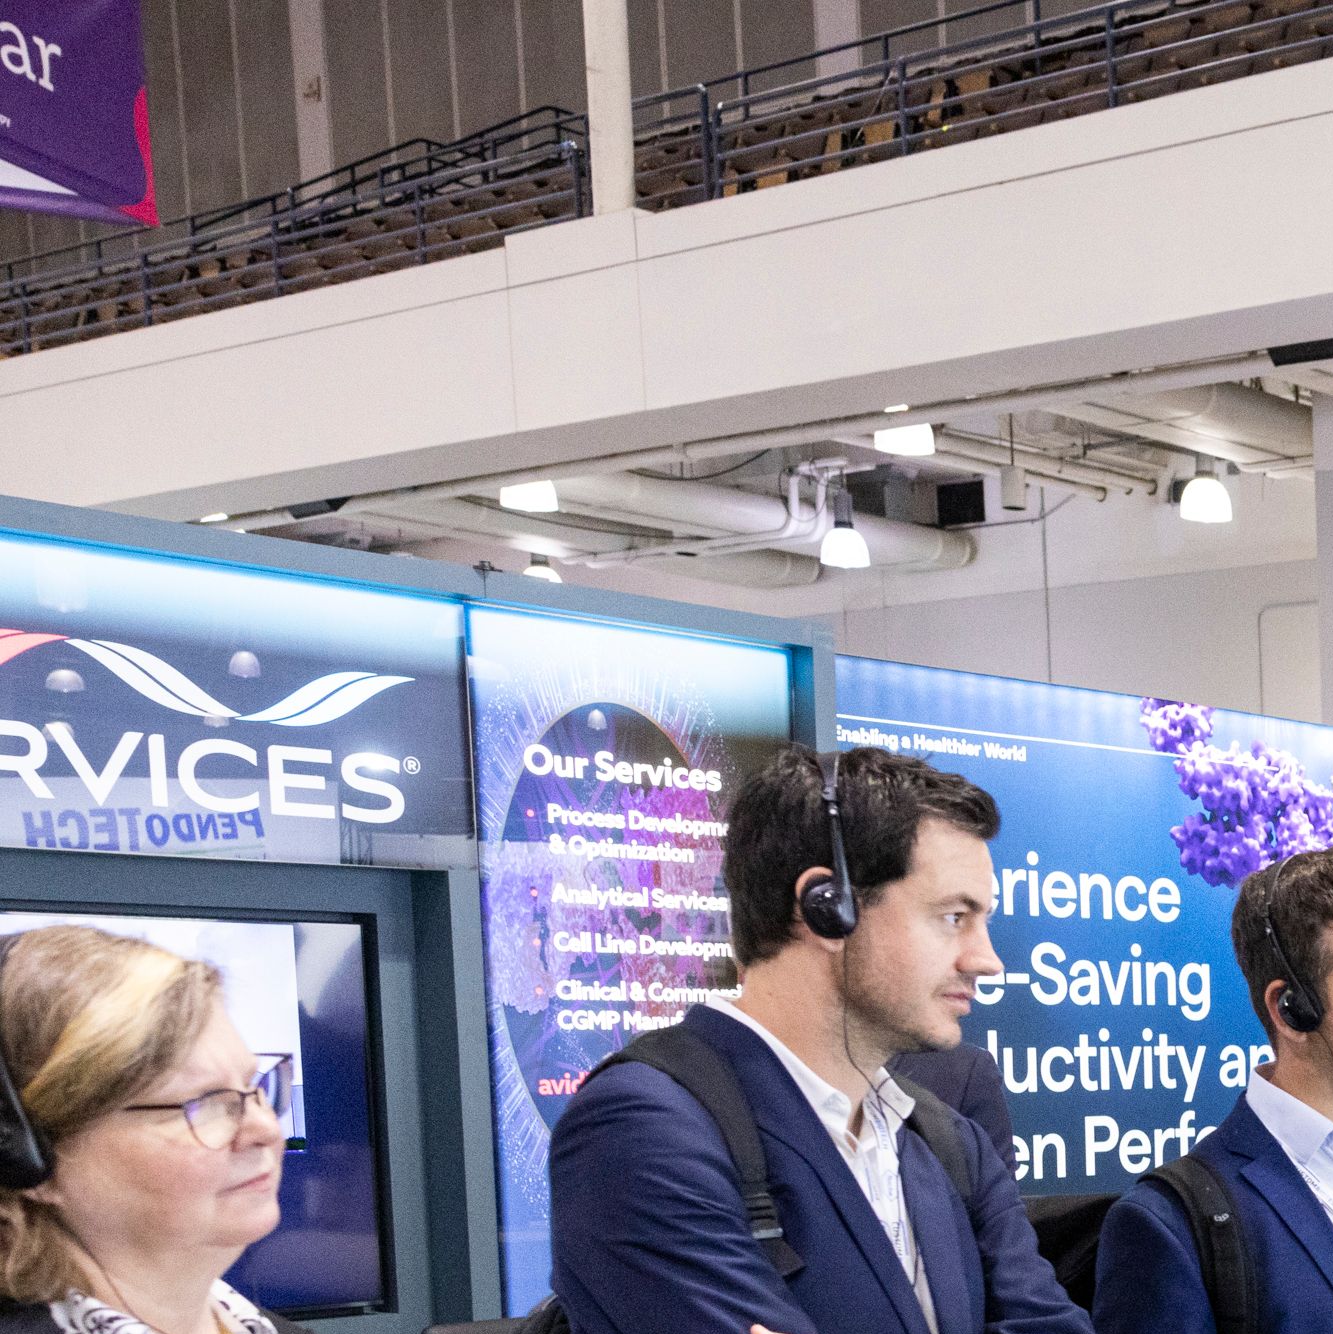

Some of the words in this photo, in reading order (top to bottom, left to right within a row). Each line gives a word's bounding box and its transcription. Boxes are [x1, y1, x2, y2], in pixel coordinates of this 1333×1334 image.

[901, 735, 911, 749] a
[914, 734, 981, 757] Healthier
[983, 741, 1027, 762] World
[523, 743, 589, 779] Our
[594, 750, 722, 792] Services
[547, 803, 626, 829] Process
[549, 833, 567, 855] &
[568, 834, 695, 863] Optimization
[551, 883, 649, 911] Analytical
[651, 887, 729, 911] Services
[991, 851, 1181, 923] rience
[553, 931, 593, 953] Cell
[594, 932, 637, 954] Line
[555, 979, 627, 1001] Clinical
[629, 981, 647, 1002] &
[557, 1009, 620, 1031] CGMP
[538, 1071, 592, 1096] avid
